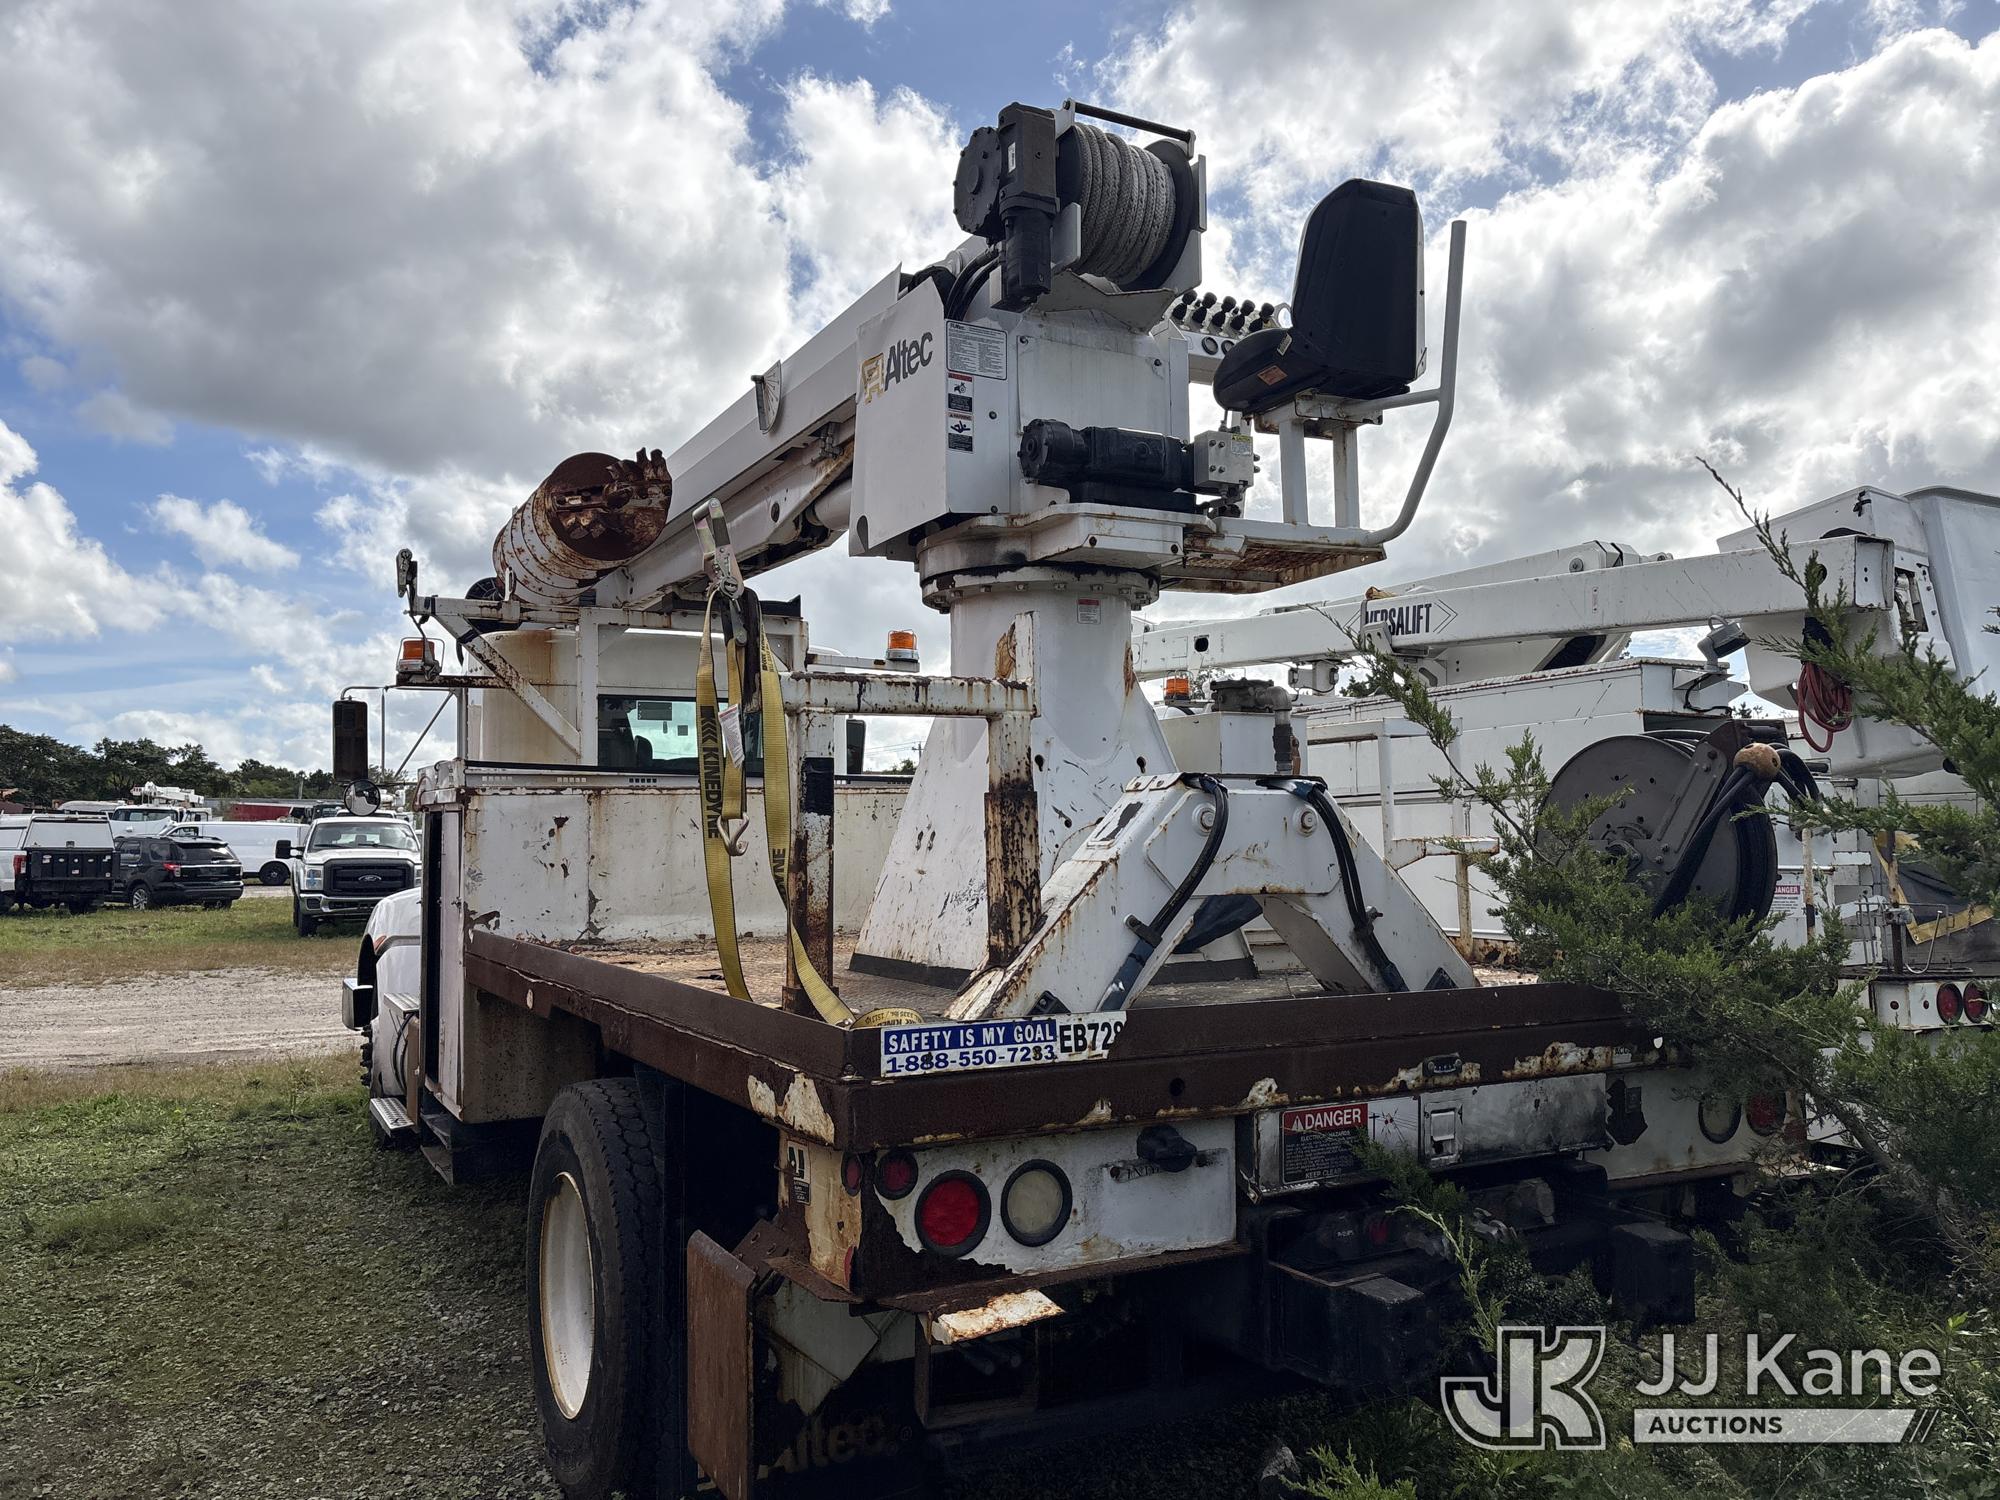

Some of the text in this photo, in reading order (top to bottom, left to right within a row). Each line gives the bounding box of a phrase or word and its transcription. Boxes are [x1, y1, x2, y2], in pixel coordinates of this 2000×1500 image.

[884, 332, 933, 391] Altec
[702, 747, 723, 839] KINEDYNE
[888, 1023, 1054, 1053] SAFETY IS MY GOAL
[1305, 1108, 1361, 1130] DANGER
